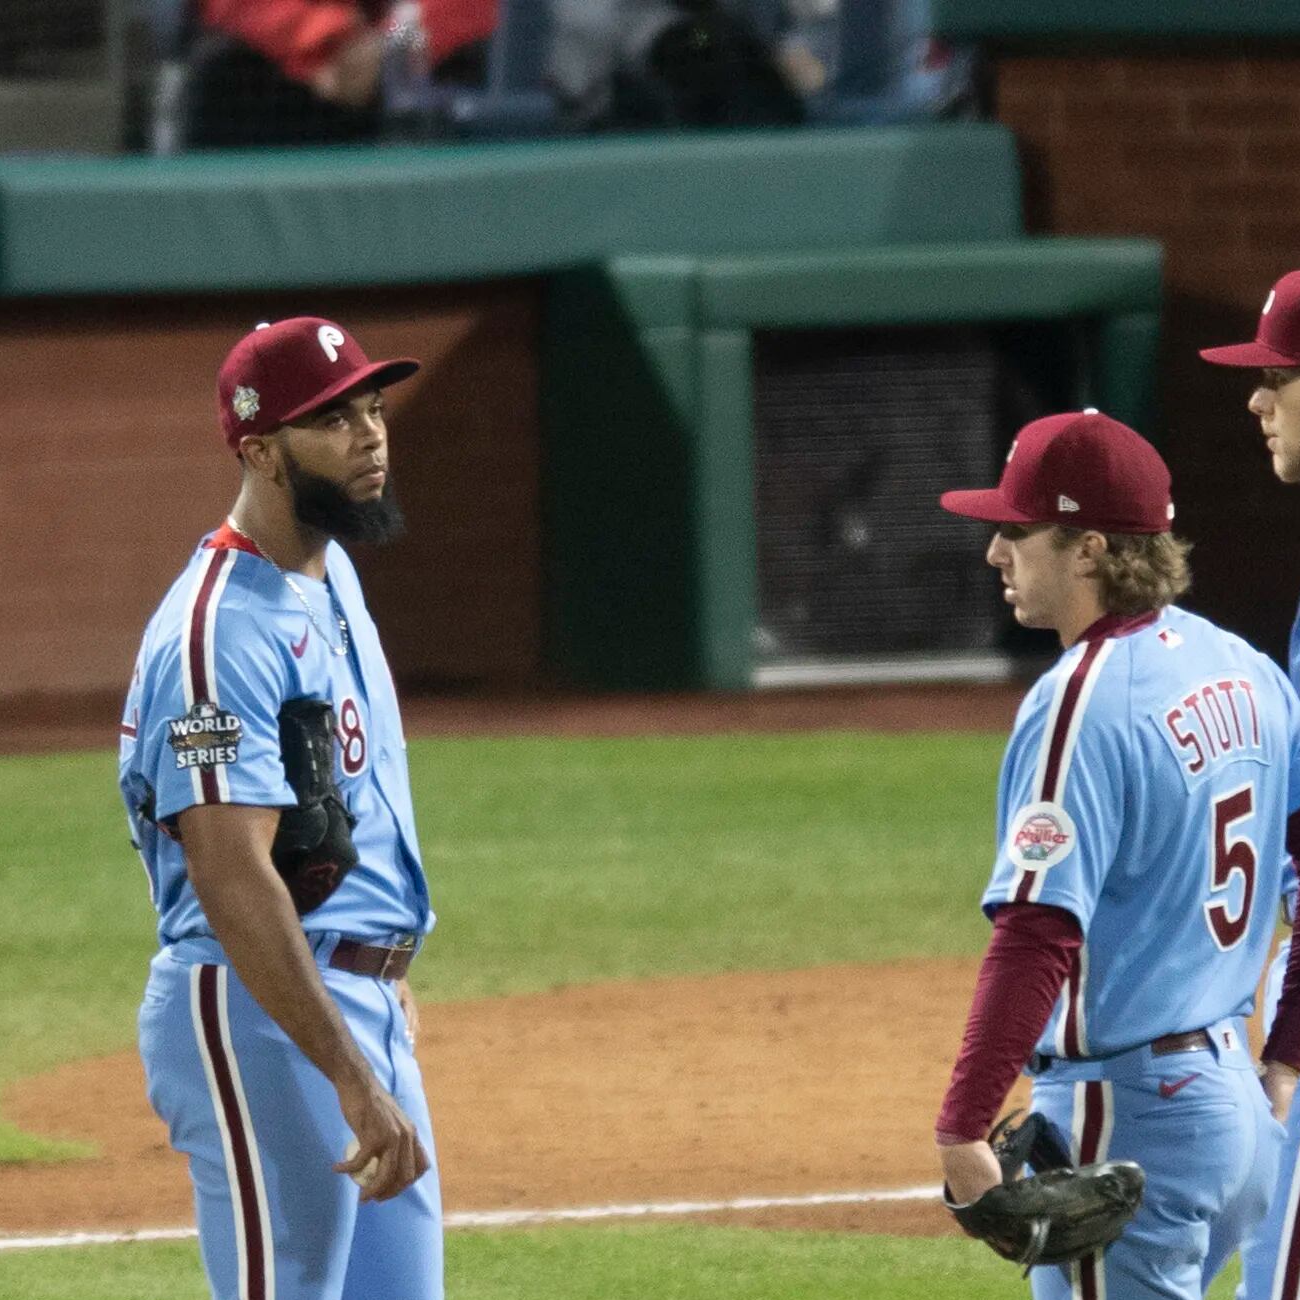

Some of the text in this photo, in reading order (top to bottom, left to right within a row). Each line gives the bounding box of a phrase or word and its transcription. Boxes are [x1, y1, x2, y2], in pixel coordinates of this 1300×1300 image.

[169, 713, 241, 738] WORLD
[1166, 678, 1261, 774] STOTT
[175, 746, 238, 770] SERIES
[1204, 781, 1260, 952] 5
